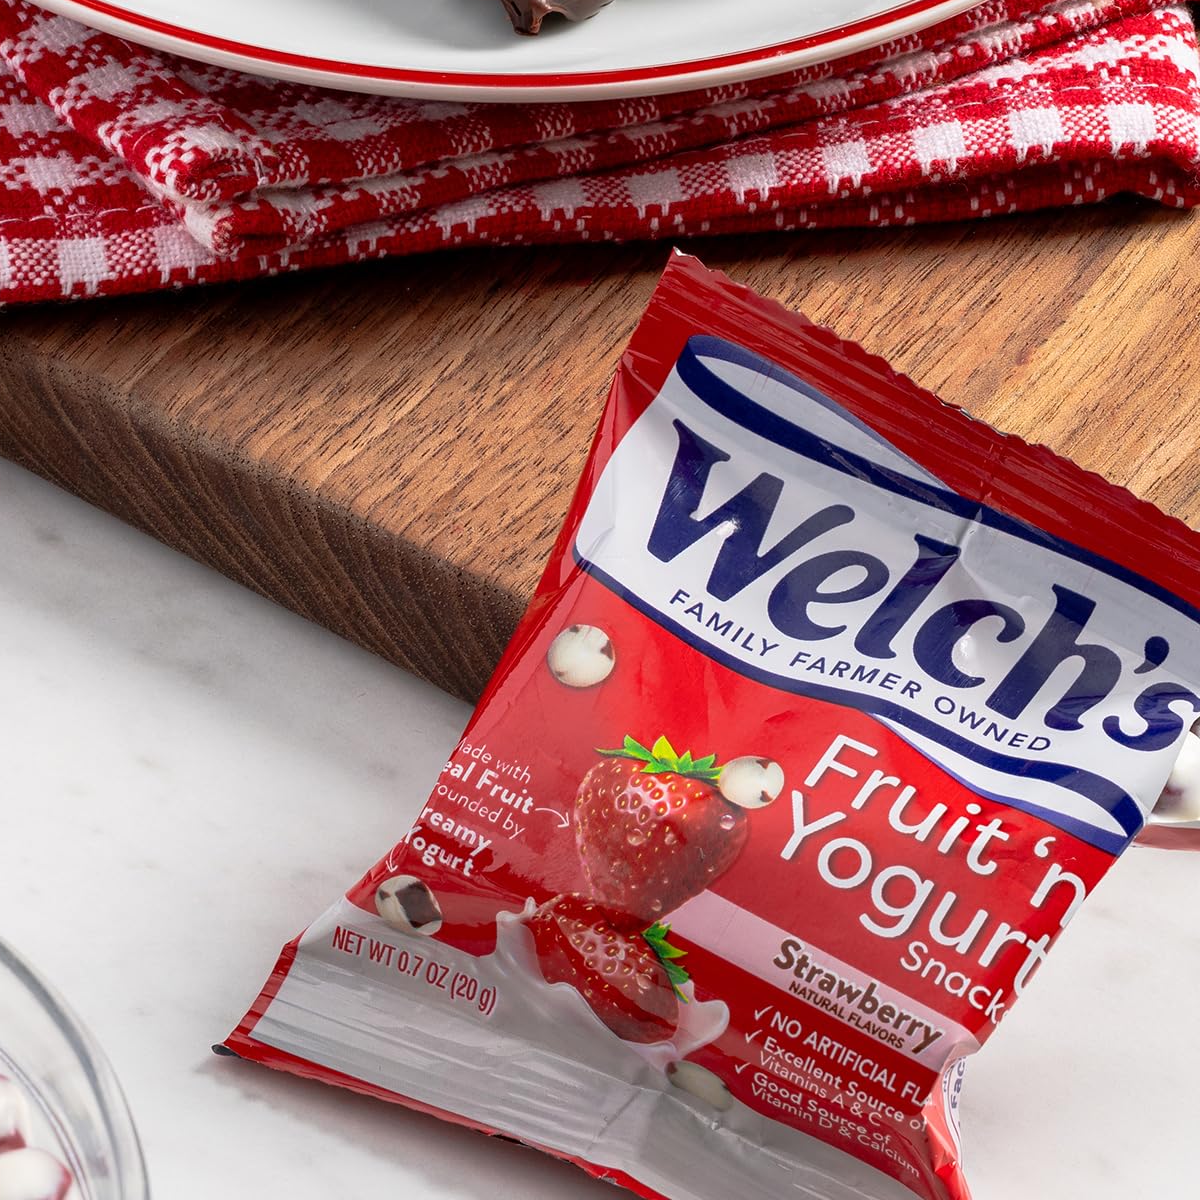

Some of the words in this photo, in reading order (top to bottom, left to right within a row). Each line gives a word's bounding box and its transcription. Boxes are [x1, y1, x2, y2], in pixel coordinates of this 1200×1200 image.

[645, 418, 1200, 751] Welch's
[670, 589, 780, 658] FAMILY
[789, 652, 922, 700] FARMER
[933, 695, 1051, 752] OWNED
[442, 760, 476, 783] eal
[475, 768, 534, 815] Fruit
[496, 760, 531, 784] with
[804, 733, 1009, 875] Fruit
[420, 807, 492, 857] reamy
[502, 813, 525, 840] by
[780, 789, 1051, 997] Yogurt
[331, 926, 366, 954] NET
[369, 939, 397, 967] WT
[397, 948, 422, 978] 0.7
[426, 962, 451, 989] OZ
[450, 971, 480, 1002] (20
[478, 986, 497, 1015] g)
[773, 939, 942, 1055] Strawberry
[770, 1011, 801, 1038] NO
[803, 1031, 896, 1092] ARTIFICIAL
[788, 981, 845, 1020] NATURAL
[848, 1014, 905, 1049] FLAVORS
[753, 1071, 802, 1106] Good
[807, 1099, 867, 1135] Source
[872, 1131, 891, 1145] of
[759, 1050, 827, 1099] Vitamins
[831, 1093, 845, 1109] A
[850, 1101, 864, 1119] &
[868, 1111, 883, 1127] C
[763, 1036, 842, 1090] Excellent
[846, 1080, 905, 1122] Source
[751, 1083, 813, 1122] Vitamin
[818, 1115, 833, 1129] D
[838, 1126, 852, 1139] &
[857, 1134, 920, 1178] Calcium
